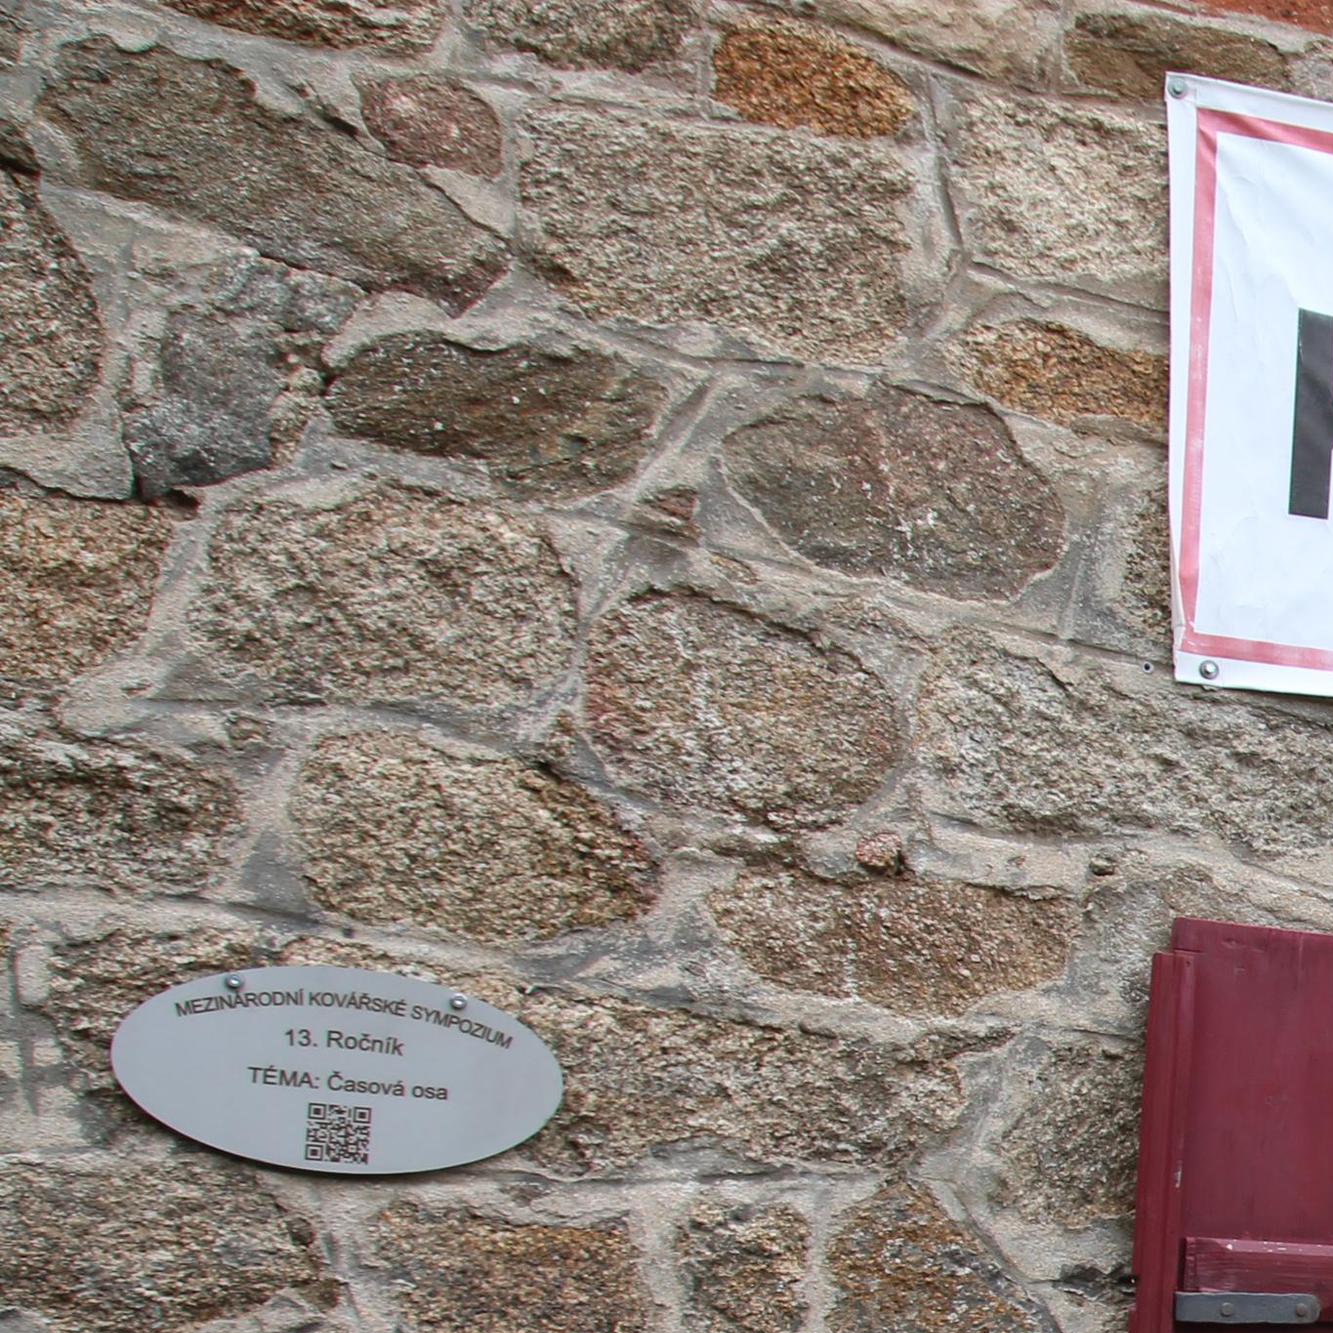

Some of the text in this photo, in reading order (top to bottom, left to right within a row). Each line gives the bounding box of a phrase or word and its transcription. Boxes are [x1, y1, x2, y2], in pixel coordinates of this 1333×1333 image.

[175, 988, 514, 1050] MEZINÁRODNÍ KOVÁŘSKÉ SYMPOZIUM
[284, 1028, 405, 1057] 13. Ročník
[247, 1065, 449, 1101] TÉMA: Časová osa
